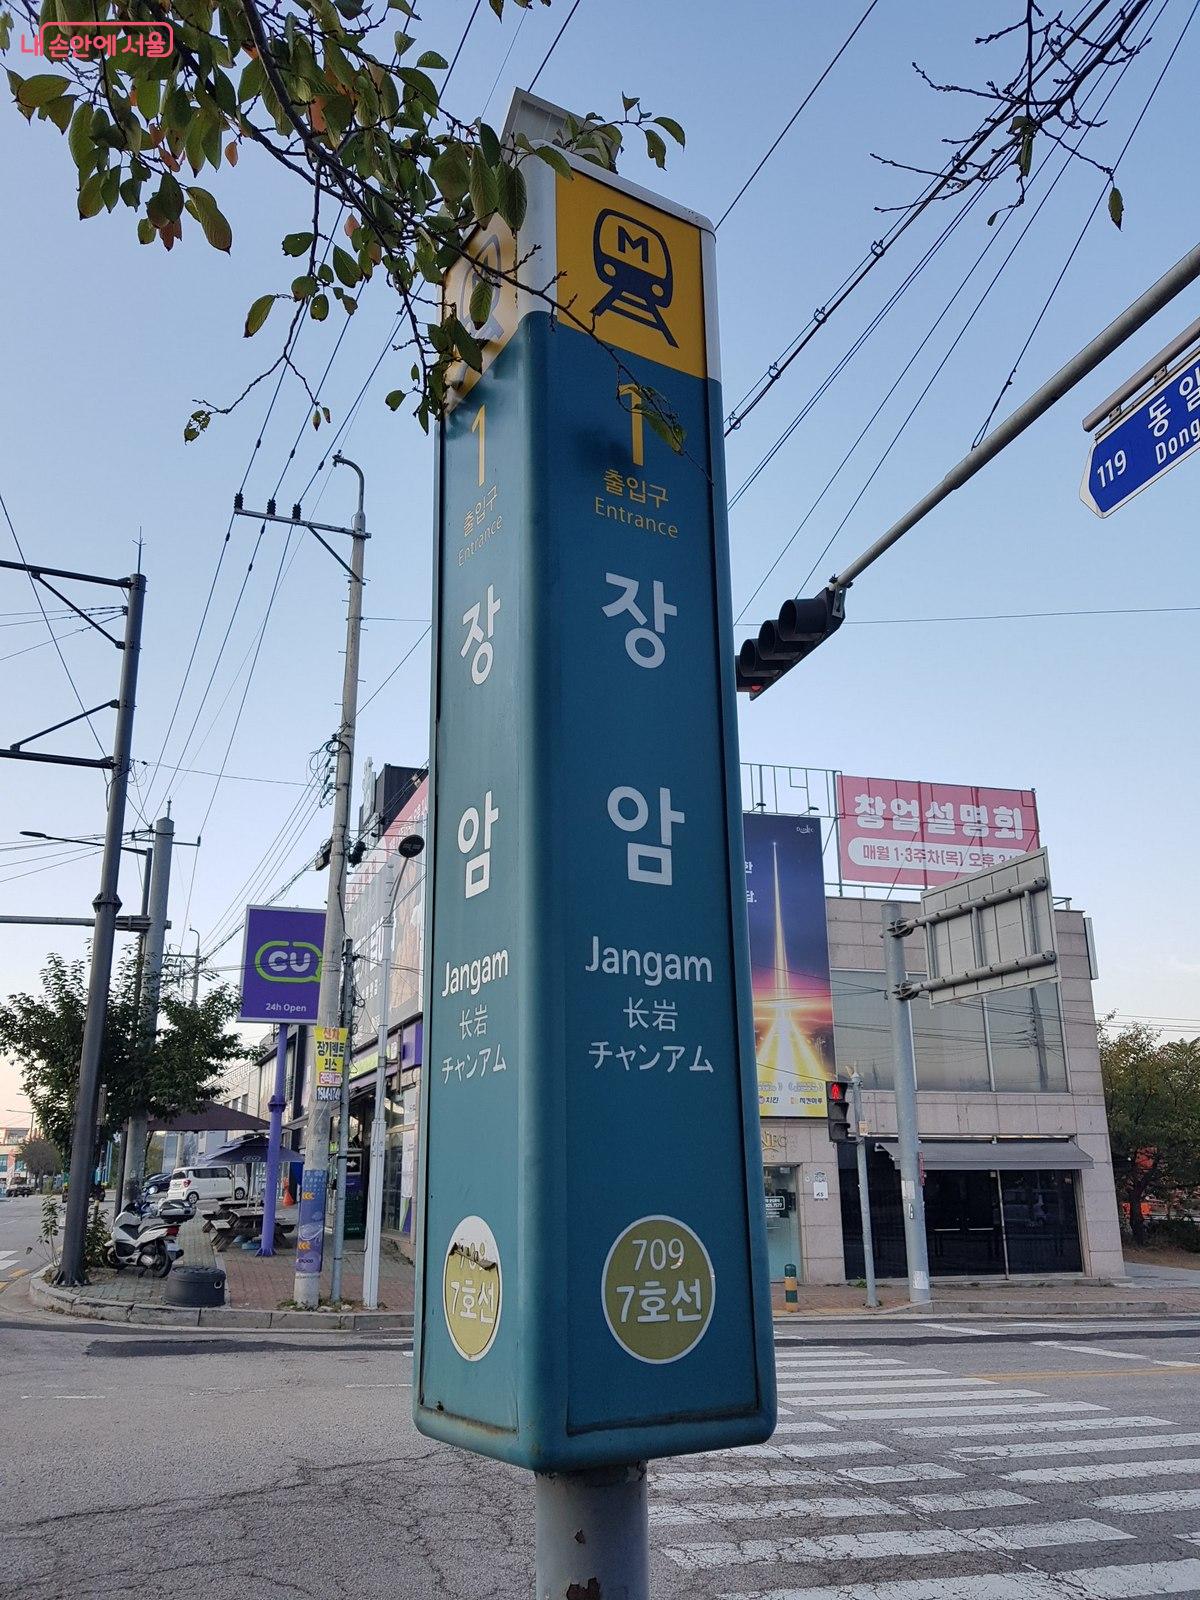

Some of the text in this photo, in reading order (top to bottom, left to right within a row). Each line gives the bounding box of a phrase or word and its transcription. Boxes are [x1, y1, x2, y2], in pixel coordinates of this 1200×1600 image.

[619, 383, 644, 466] 1
[472, 404, 486, 488] 1
[603, 468, 668, 508] 출입구
[1097, 450, 1127, 488] 119
[464, 485, 497, 537] 출입구
[595, 497, 678, 539] Entrance
[458, 514, 503, 567] Entrance
[854, 794, 1024, 840] 창업설명회
[863, 844, 890, 861] 매월
[269, 951, 311, 972] CU
[441, 950, 509, 997] Jangam
[585, 936, 713, 986] Jangam
[266, 1003, 306, 1013] 24h Open
[459, 1004, 488, 1041] 长岩
[623, 997, 678, 1032] 长岩
[441, 1044, 507, 1084] チャンアム
[588, 1041, 714, 1073] チャンアム
[632, 1238, 685, 1271] 709
[450, 1279, 495, 1323] 7호선
[616, 1278, 702, 1323] 7호선
